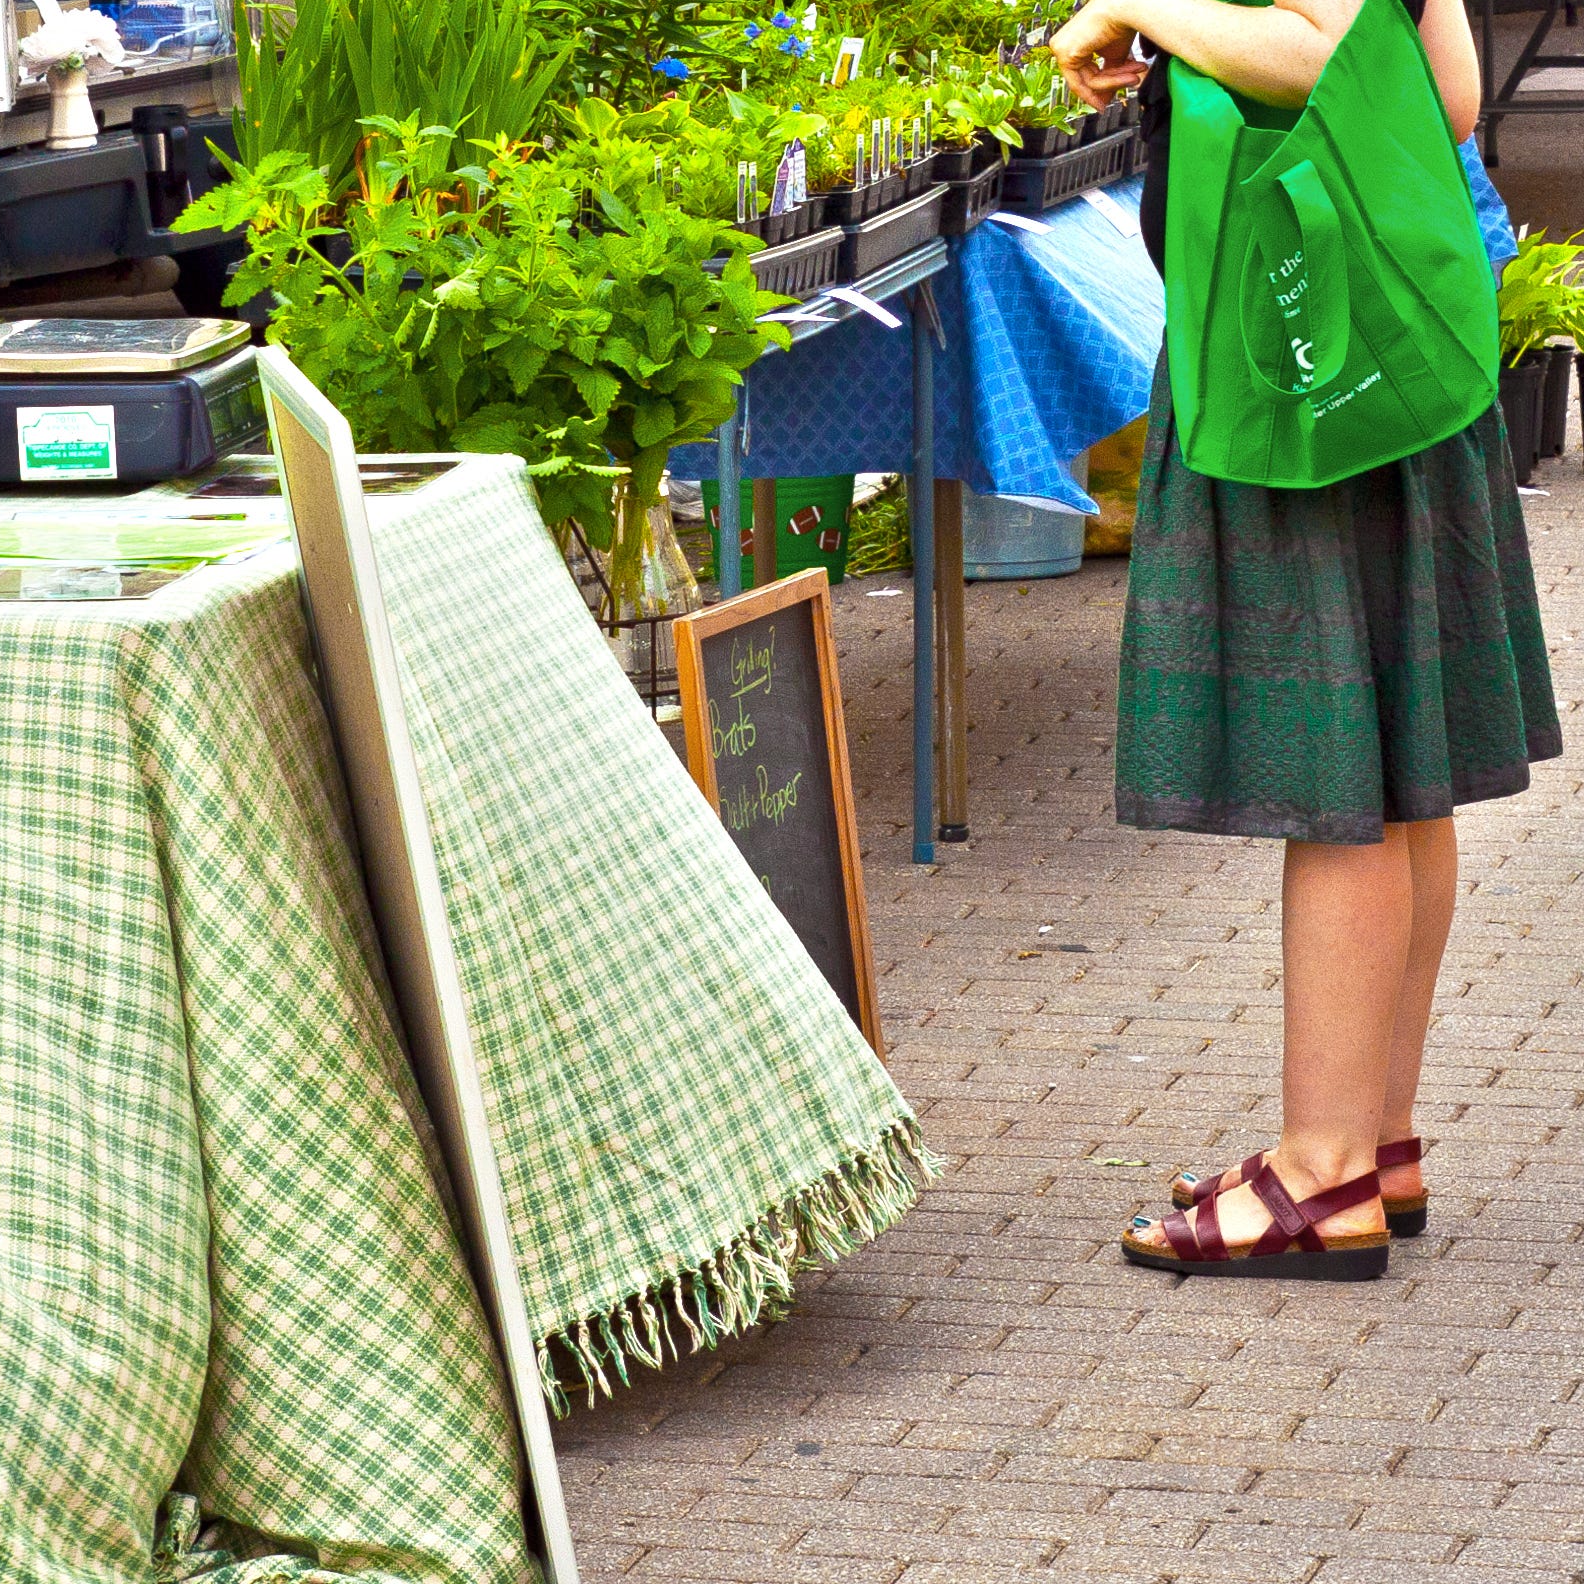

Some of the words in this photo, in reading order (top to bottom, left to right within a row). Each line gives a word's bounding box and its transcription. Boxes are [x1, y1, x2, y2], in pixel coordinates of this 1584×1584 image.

[1327, 390, 1355, 410] Upper
[1354, 370, 1382, 393] Valley
[708, 699, 757, 759] Brats
